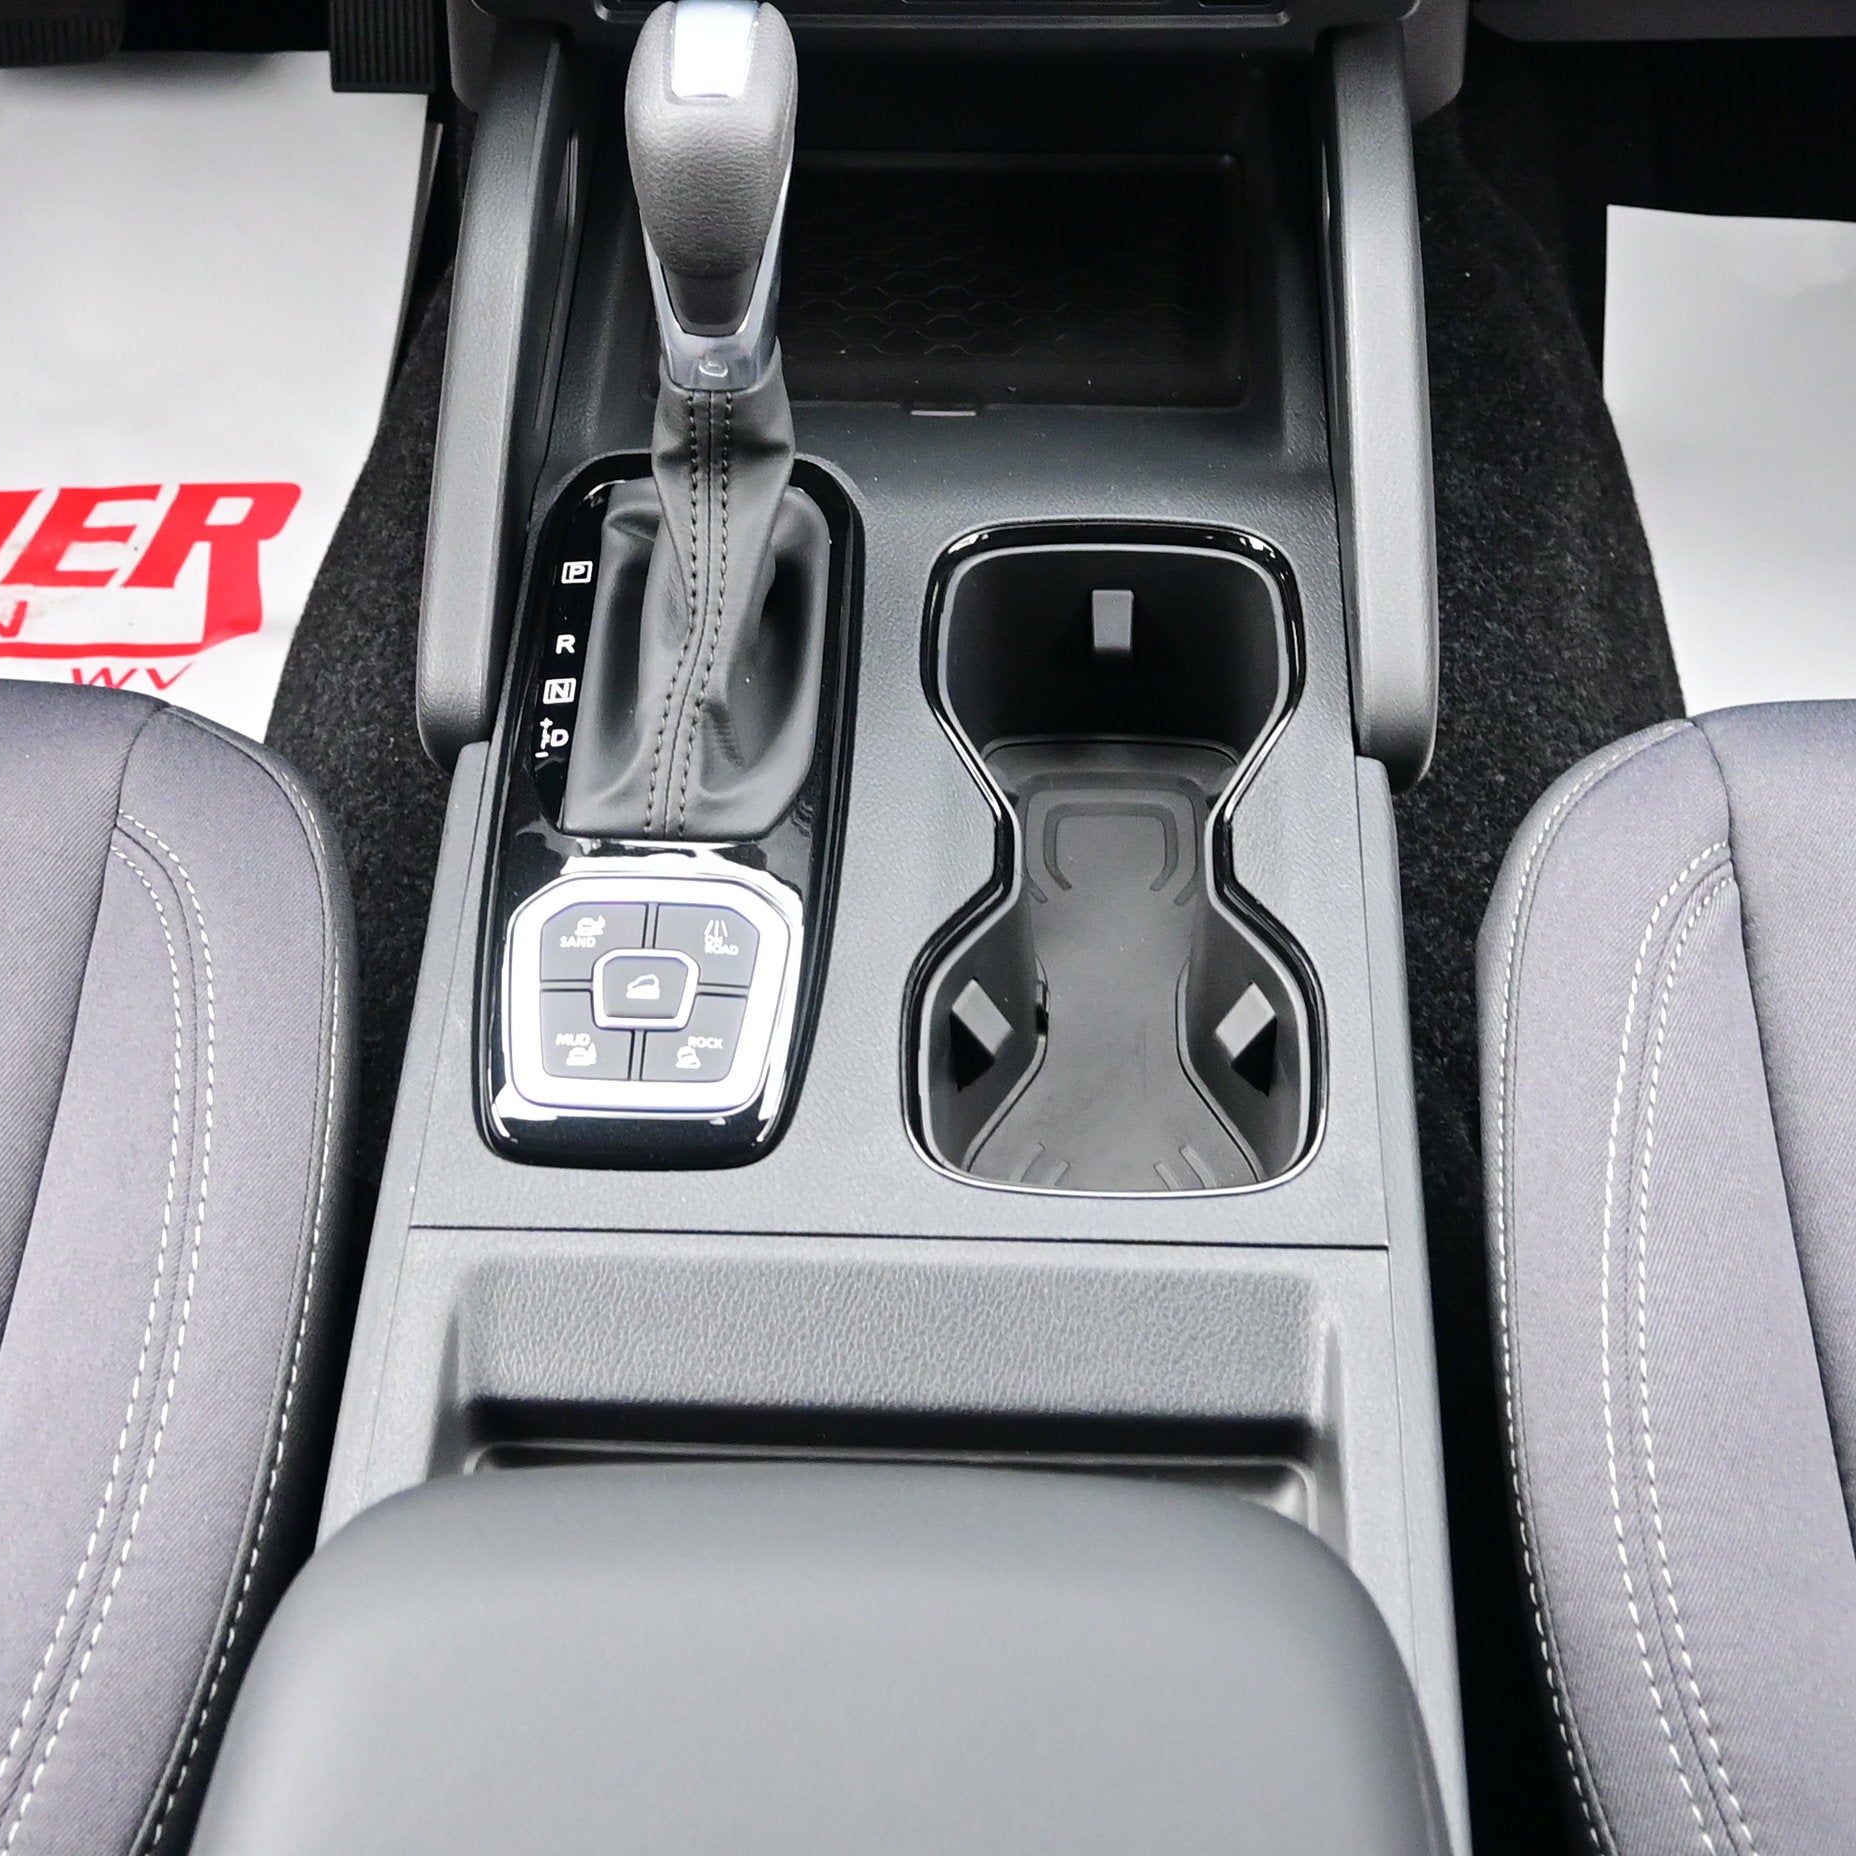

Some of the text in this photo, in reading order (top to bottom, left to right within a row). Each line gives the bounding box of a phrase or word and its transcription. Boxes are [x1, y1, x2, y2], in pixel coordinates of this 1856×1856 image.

[570, 566, 585, 580] P
[556, 635, 575, 654] R
[550, 682, 569, 700] N
[551, 730, 569, 747] D
[560, 936, 597, 949] SAND
[705, 944, 739, 956] ROAD
[555, 1033, 591, 1046] MUD
[688, 1036, 724, 1050] ROCK
